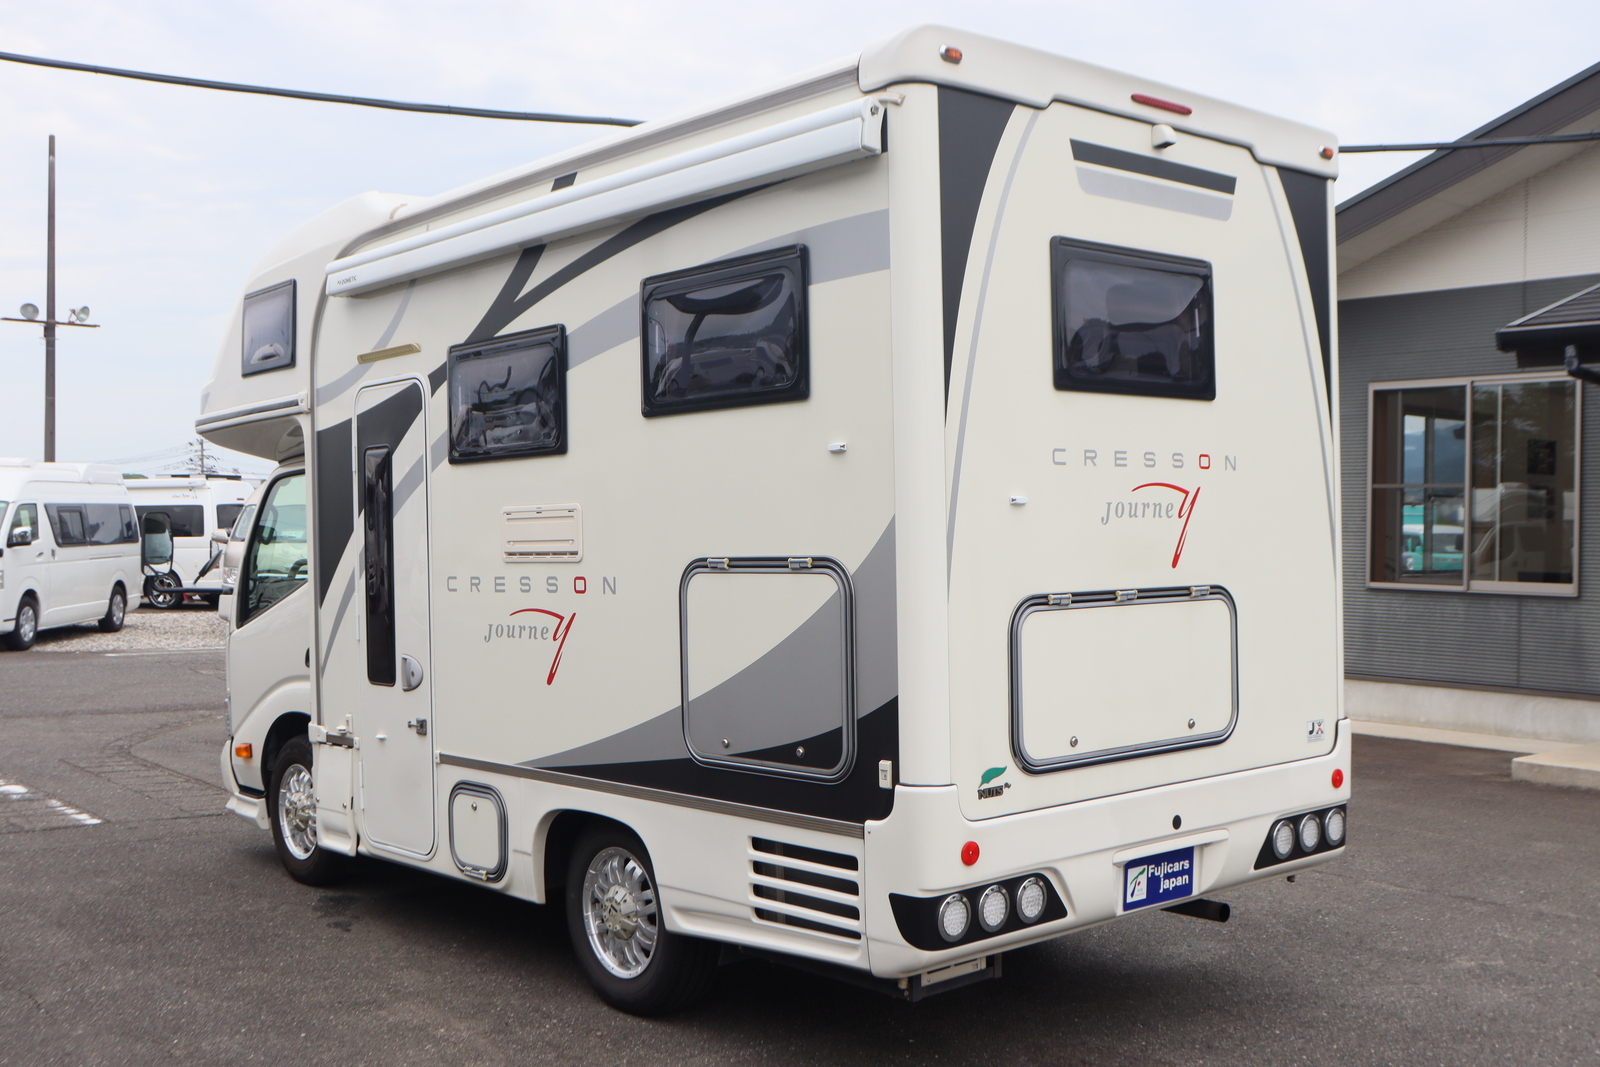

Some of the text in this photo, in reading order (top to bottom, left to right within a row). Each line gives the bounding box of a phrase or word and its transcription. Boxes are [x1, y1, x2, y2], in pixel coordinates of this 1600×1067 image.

[1052, 447, 1237, 471] CRESSON
[446, 575, 617, 594] CRESSON
[1308, 720, 1324, 735] JX
[977, 786, 1003, 800] NUTS
[1148, 860, 1190, 877] Fujicars
